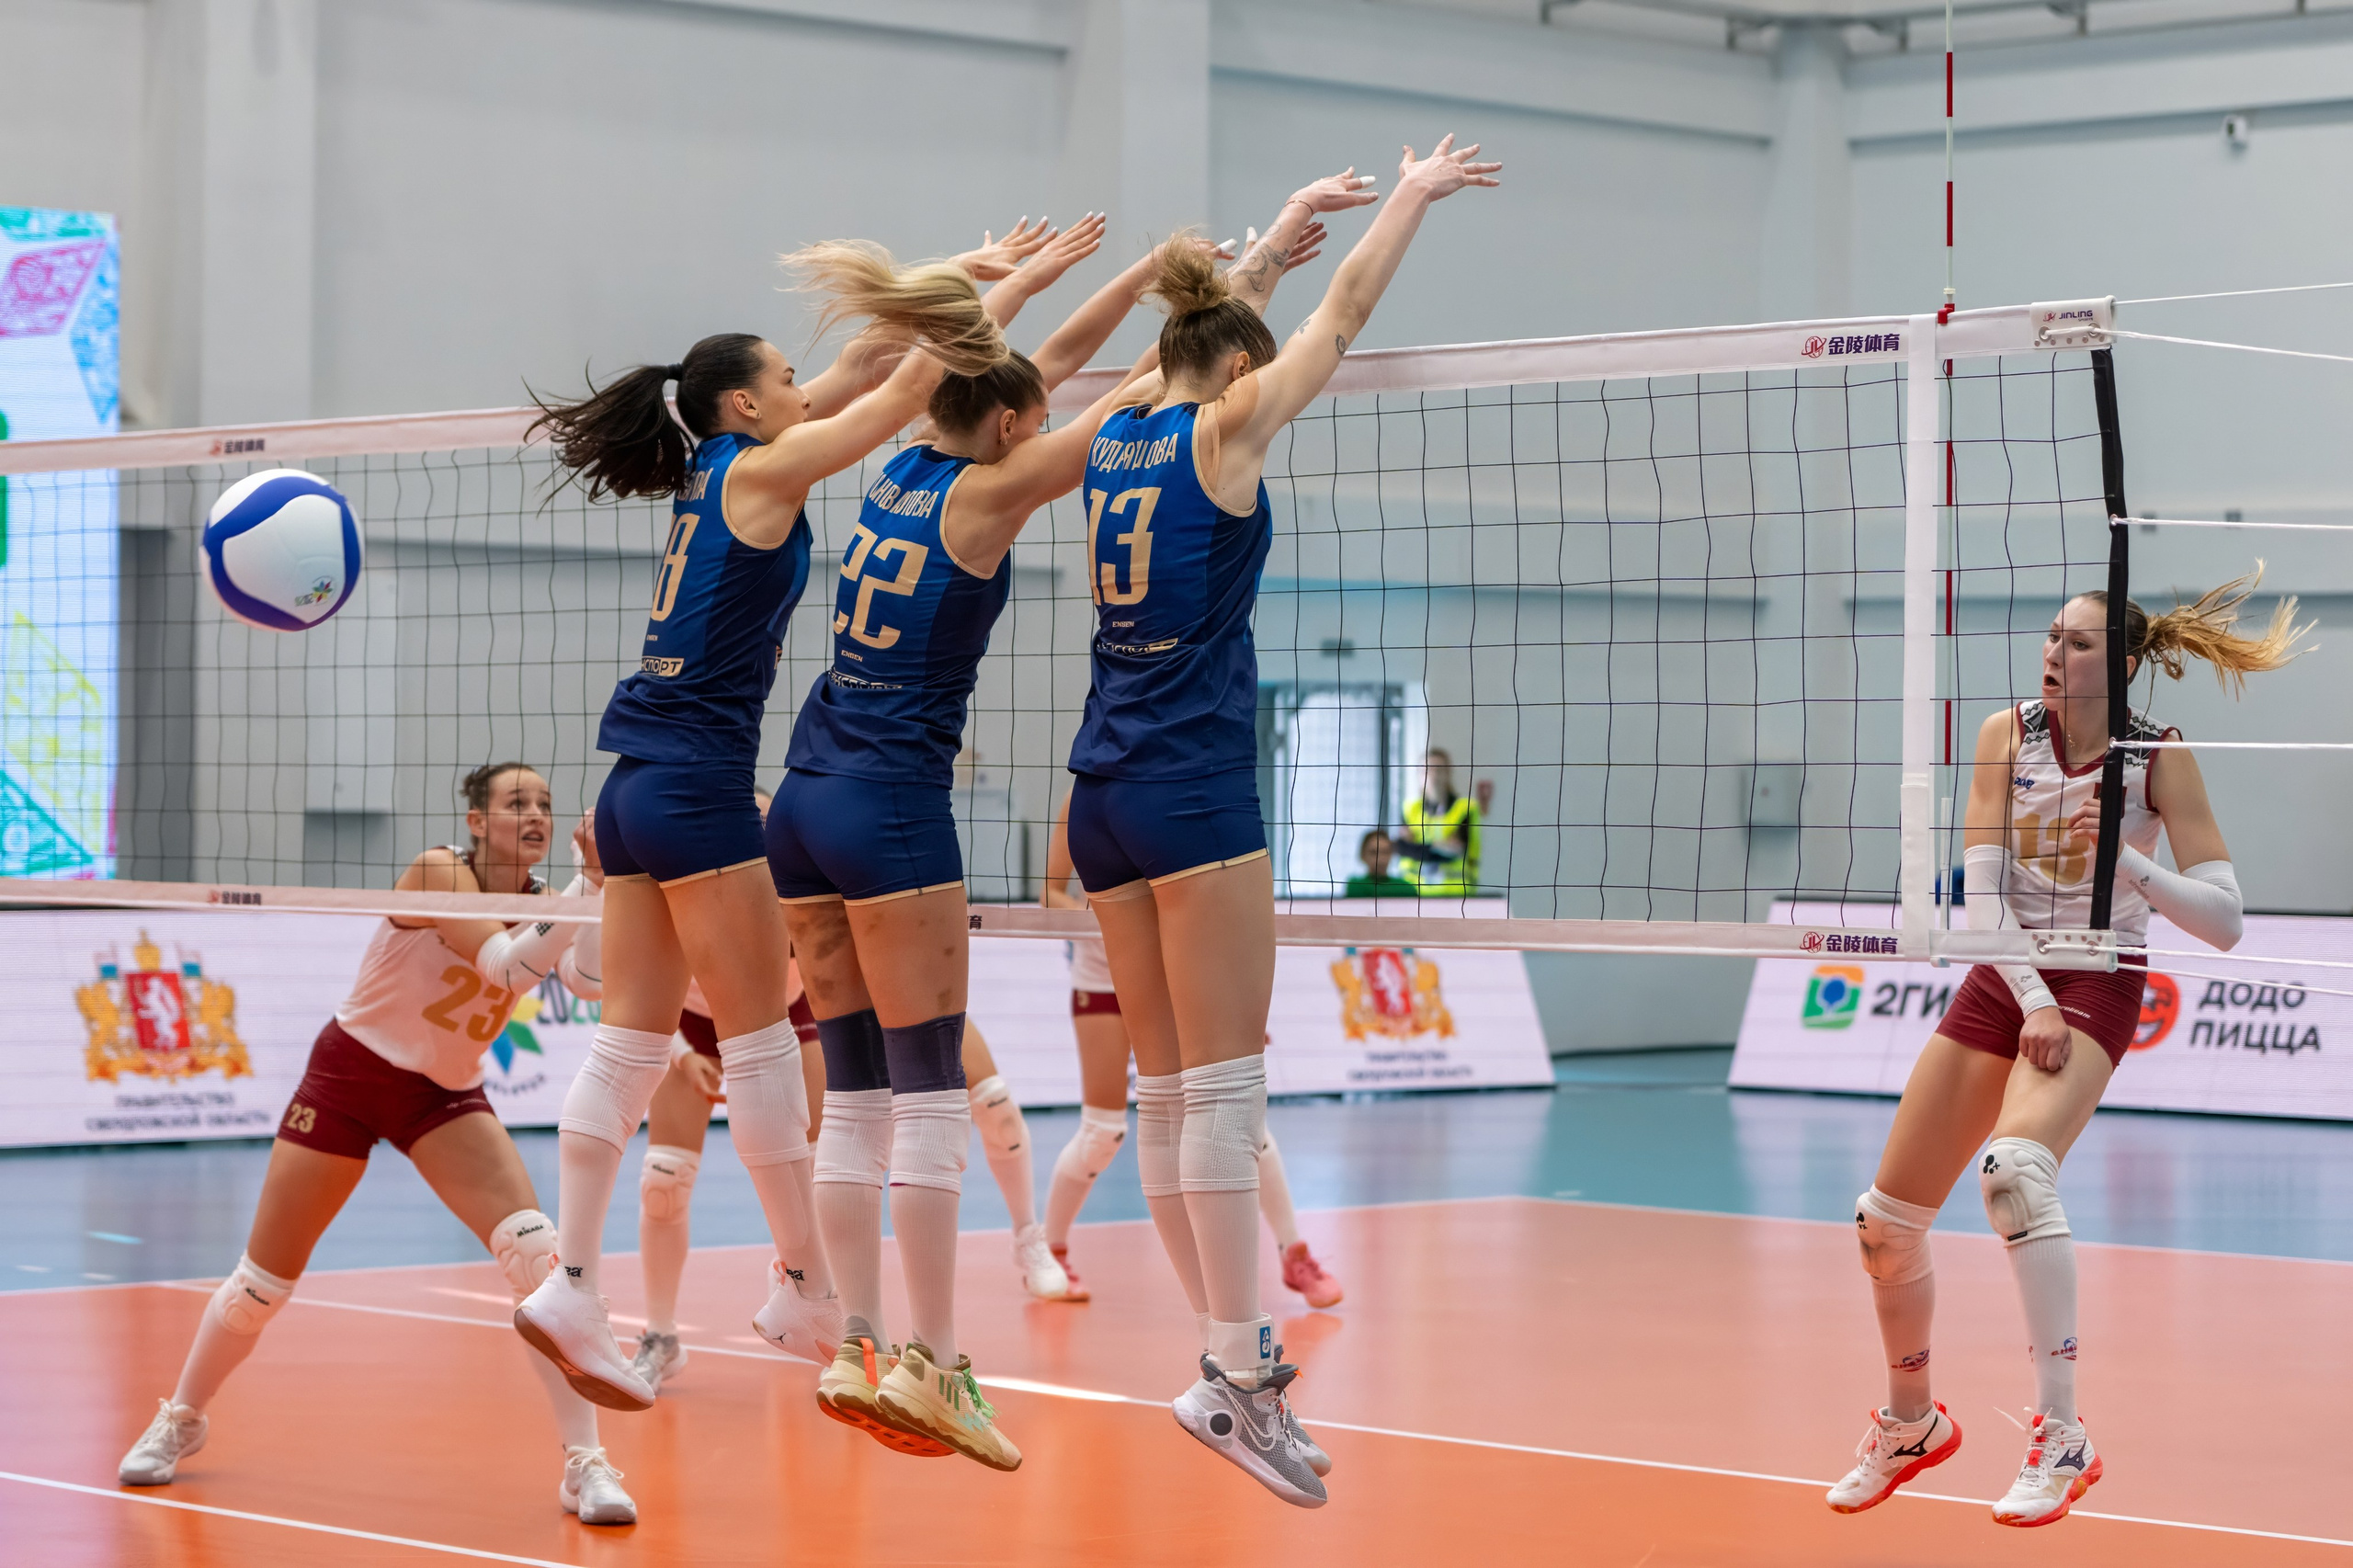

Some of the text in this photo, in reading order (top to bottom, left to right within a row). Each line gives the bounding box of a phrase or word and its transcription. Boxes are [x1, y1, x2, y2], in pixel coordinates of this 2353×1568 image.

[2059, 310, 2093, 320] JINLING
[1828, 334, 1900, 356] 金陵体育
[1089, 486, 1162, 606] 13
[650, 512, 700, 621] 8
[1826, 934, 1899, 955] 金陵体育
[422, 965, 515, 1041] 23
[1870, 982, 1956, 1018] 2ГИ
[2199, 980, 2306, 1012] ДОДО
[2189, 1020, 2321, 1055] ПИЦЦА
[288, 1103, 317, 1133] 23
